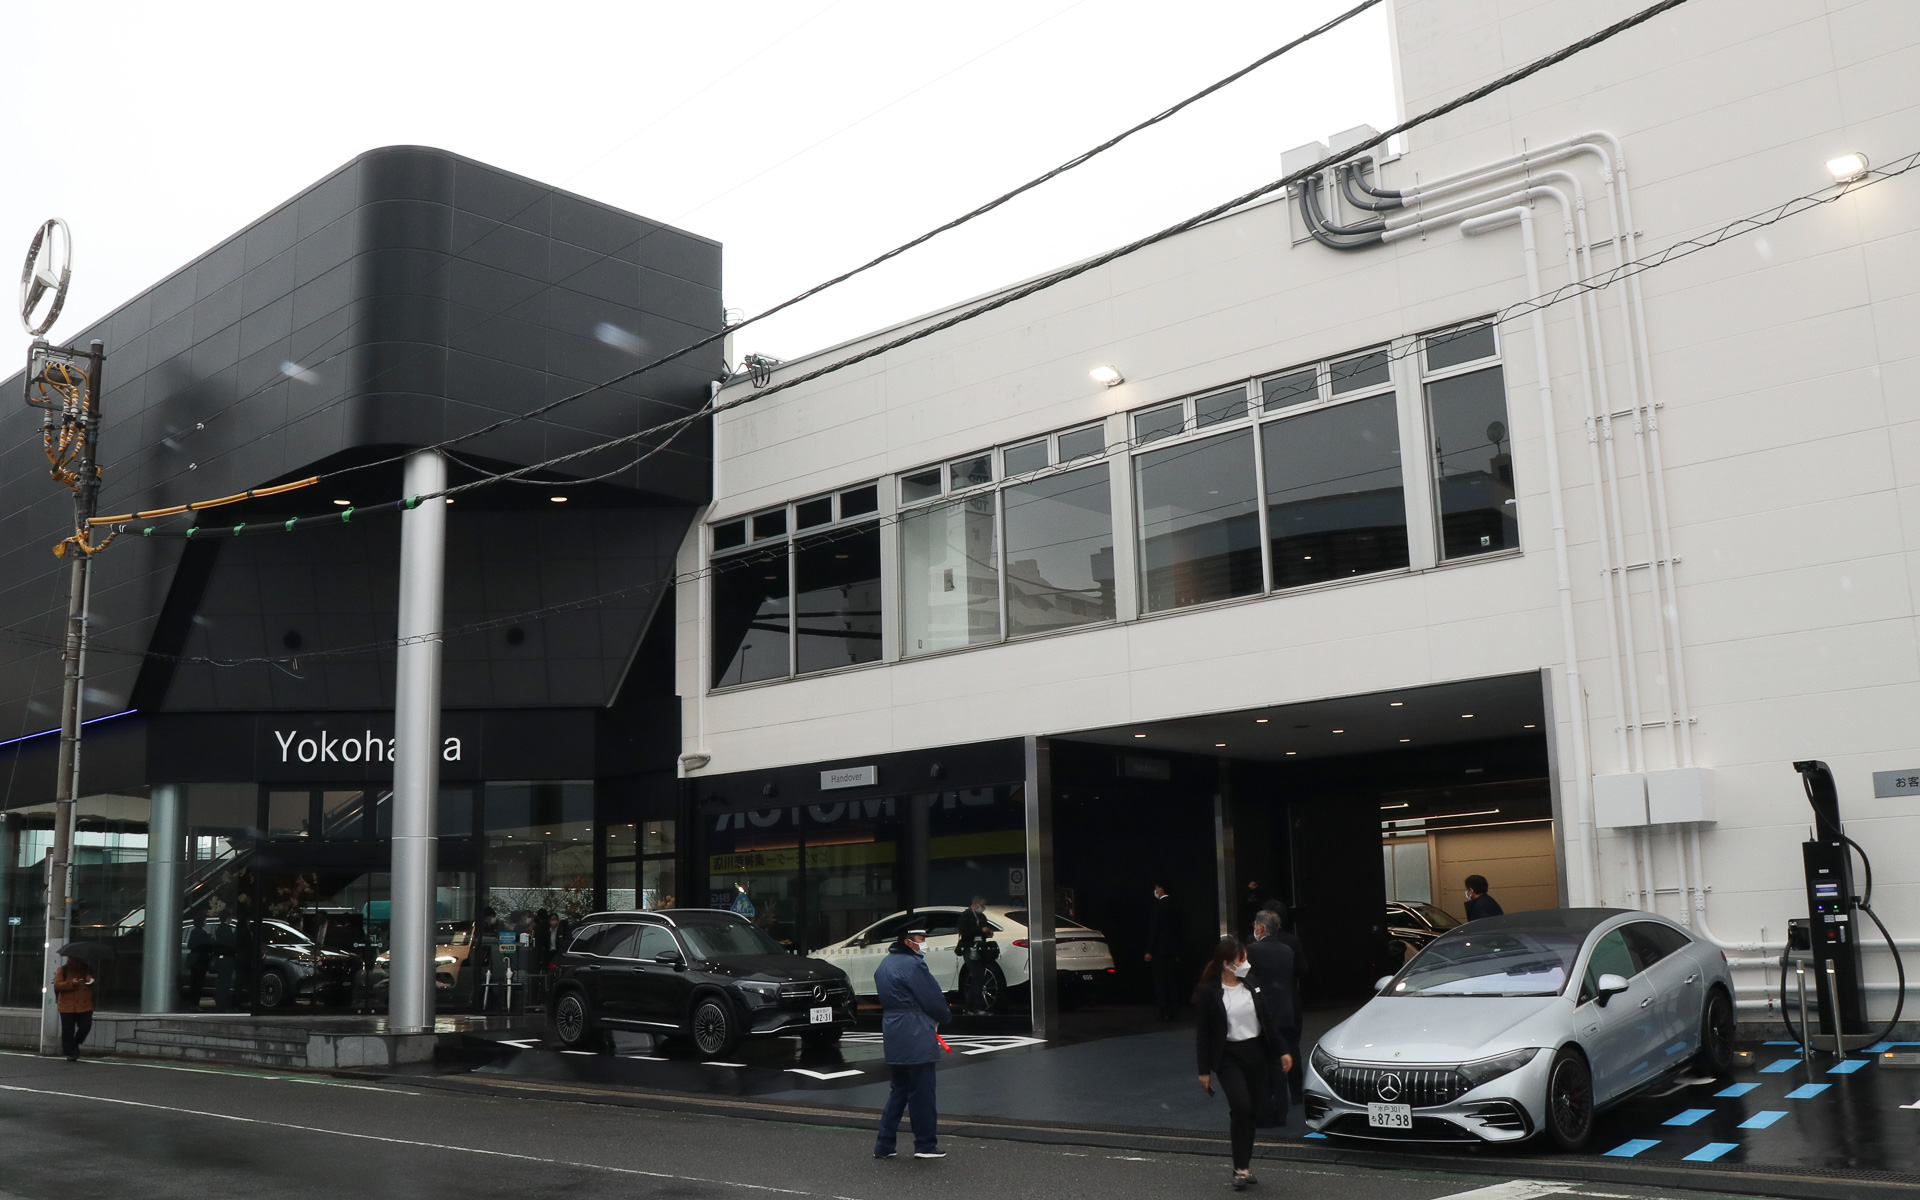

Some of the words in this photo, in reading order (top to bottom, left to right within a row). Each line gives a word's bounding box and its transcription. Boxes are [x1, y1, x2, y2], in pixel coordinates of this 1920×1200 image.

[274, 729, 462, 763] Yokoha
[831, 773, 863, 784] Handover
[1895, 776, 1920, 788] お客
[1377, 1113, 1409, 1126] 87-98
